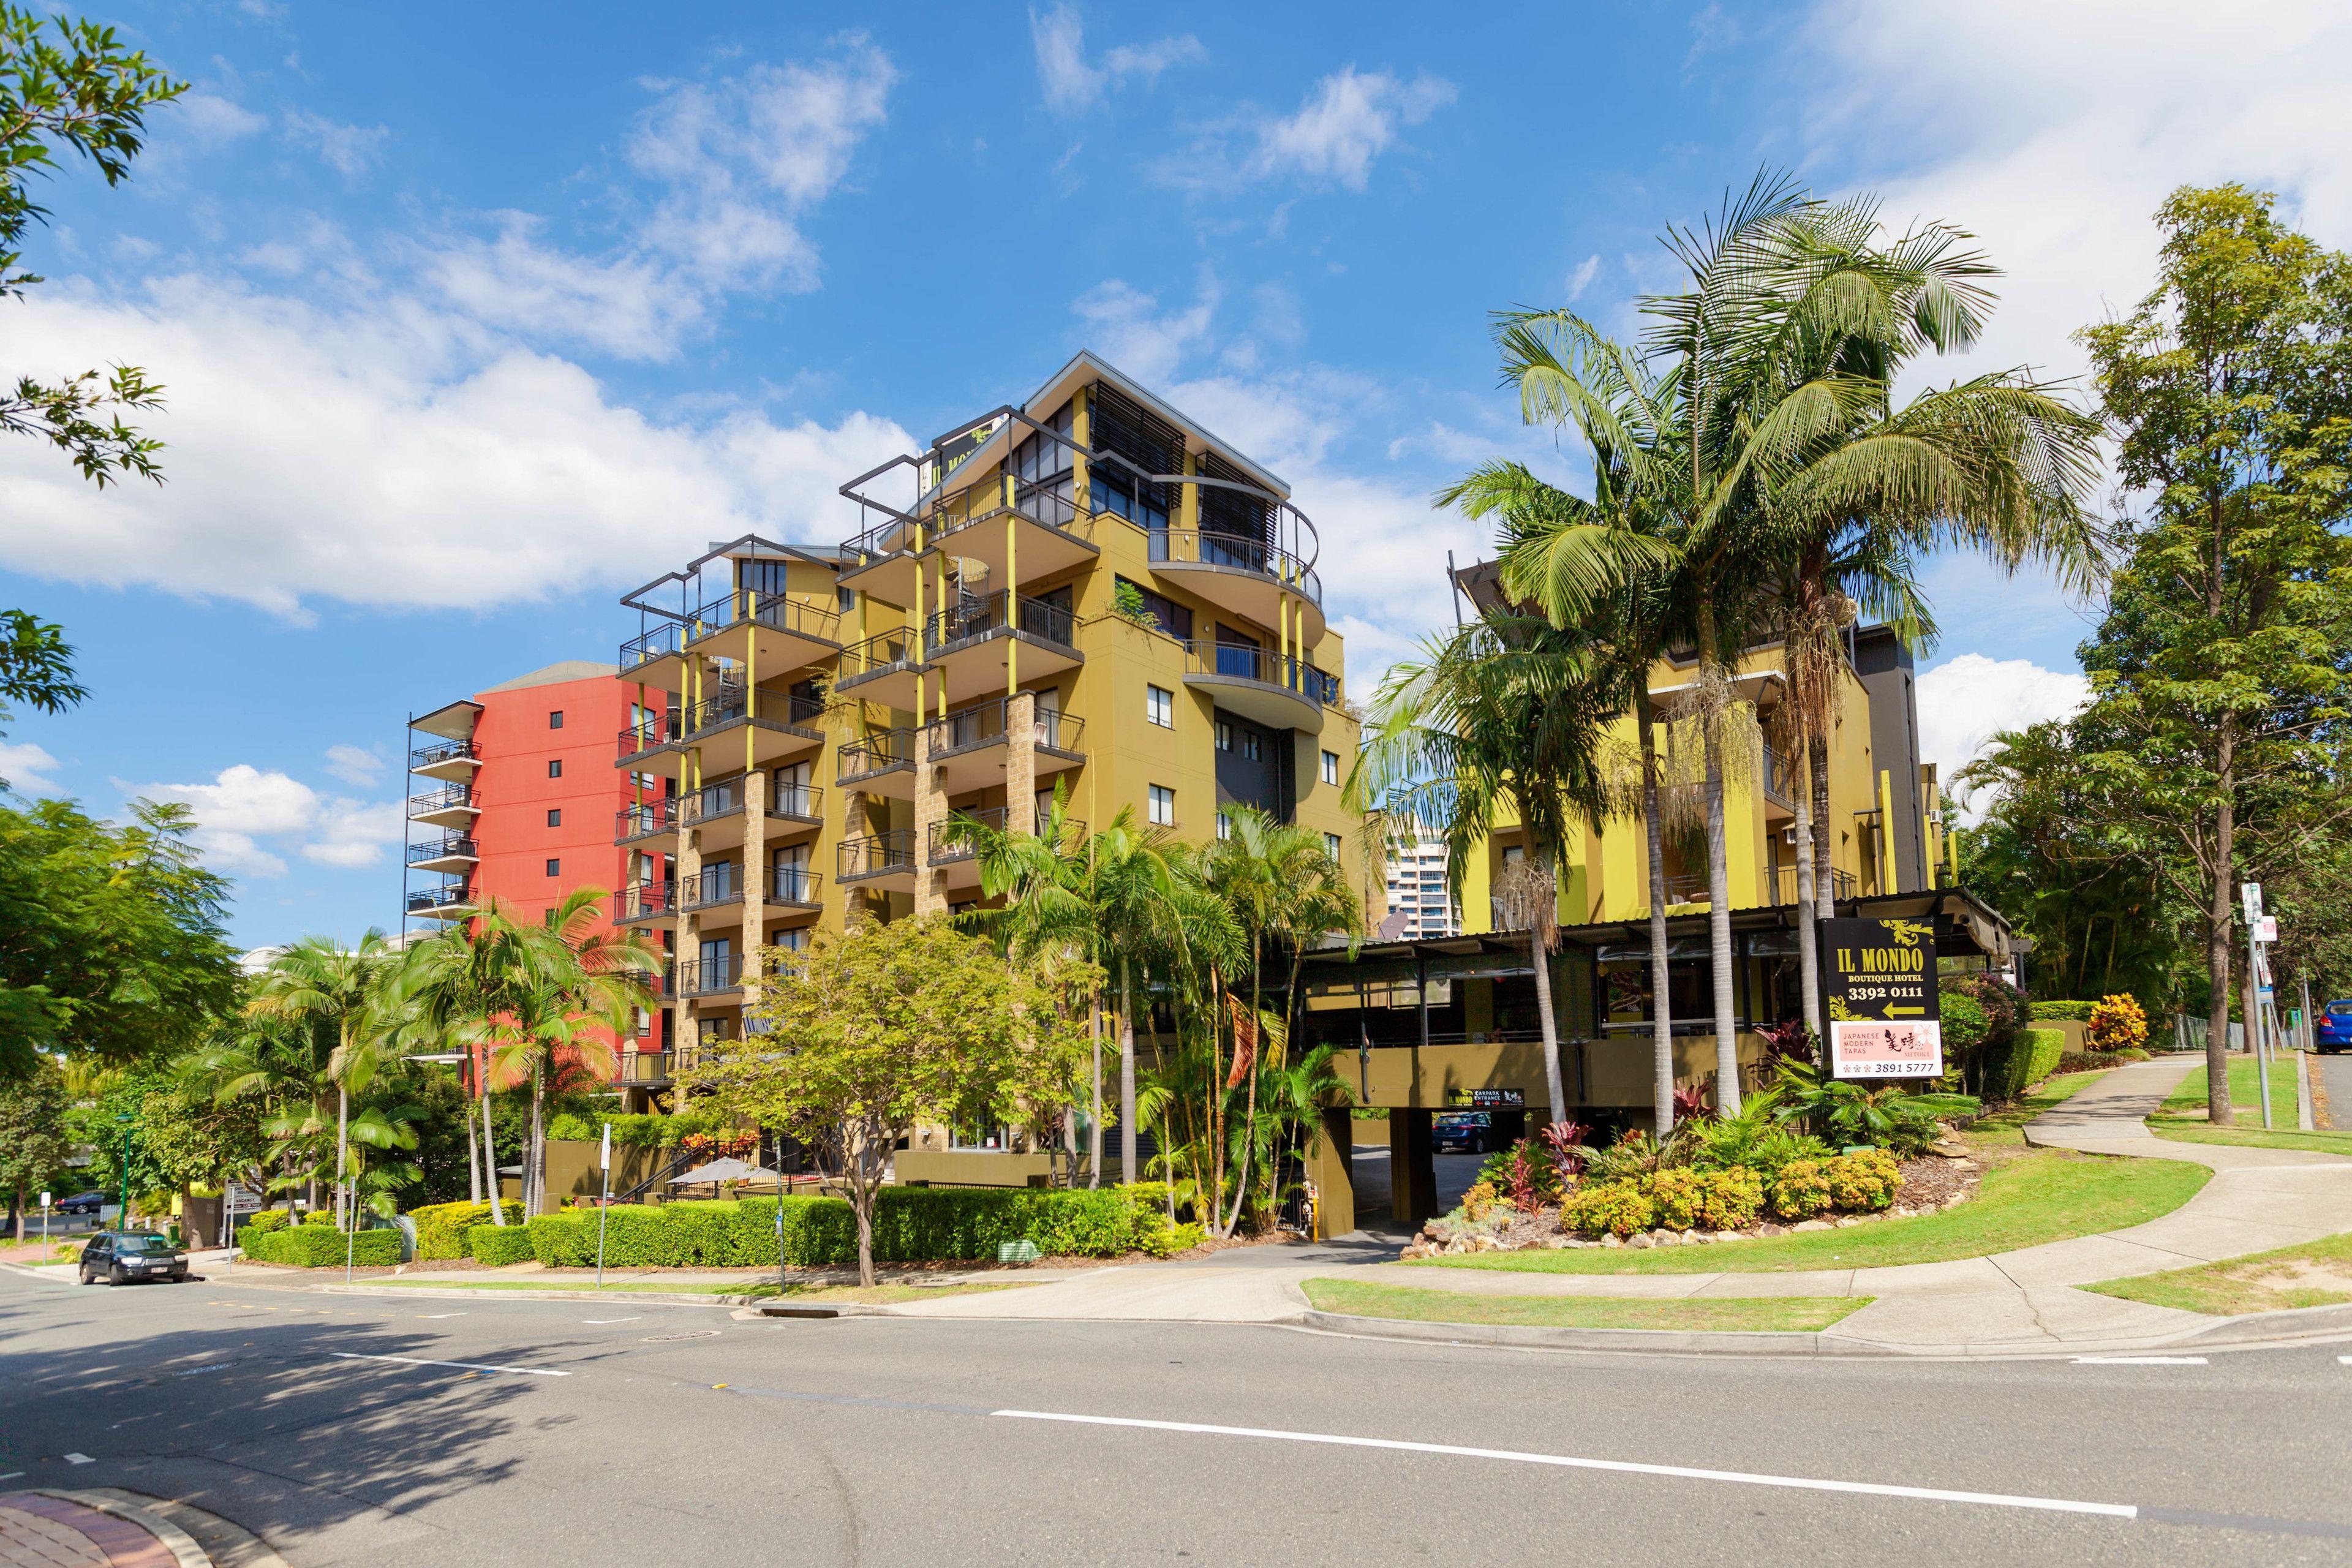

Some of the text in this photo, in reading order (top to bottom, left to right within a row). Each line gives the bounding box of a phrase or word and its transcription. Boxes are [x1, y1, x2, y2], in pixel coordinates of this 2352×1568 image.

[1838, 948, 1924, 973] IL MONDO
[1849, 987, 1923, 1000] 3392 0111
[1875, 1063, 1934, 1072] 3891 5777
